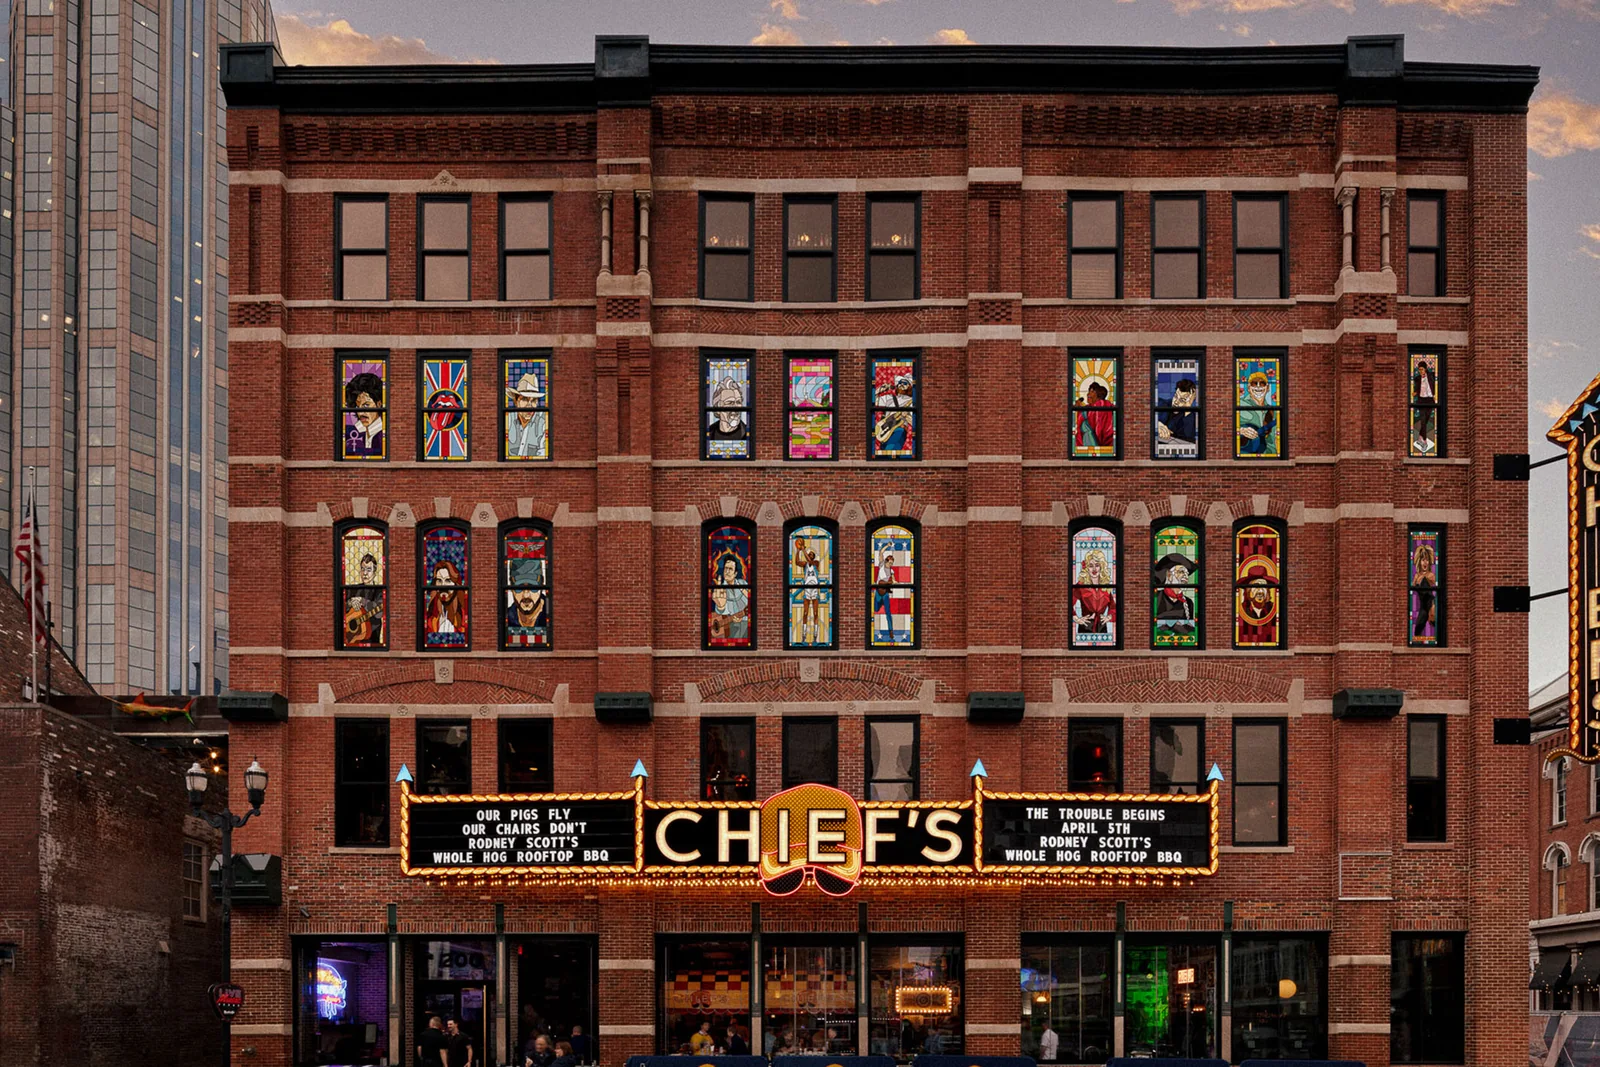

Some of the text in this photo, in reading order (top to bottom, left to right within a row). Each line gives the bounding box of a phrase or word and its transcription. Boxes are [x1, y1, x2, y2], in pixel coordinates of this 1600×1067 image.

[477, 808, 571, 822] OUR PIGS FLY
[1026, 807, 1166, 821] THE TROUBLE BEGINS
[462, 822, 587, 836] OUR CHAIRS DON'T
[1061, 822, 1131, 835] APRIL 5TH
[468, 837, 579, 850] RODNEY SCOTT'S
[655, 808, 962, 865] CHIEF'S
[1040, 836, 1152, 849] RODNEY SCOTT'S
[433, 850, 609, 864] WHOLE HOG ROOFTOP BBQ
[1005, 850, 1183, 864] WHOLE HOG ROOFTOP BBQ
[218, 988, 242, 997] LIVE
